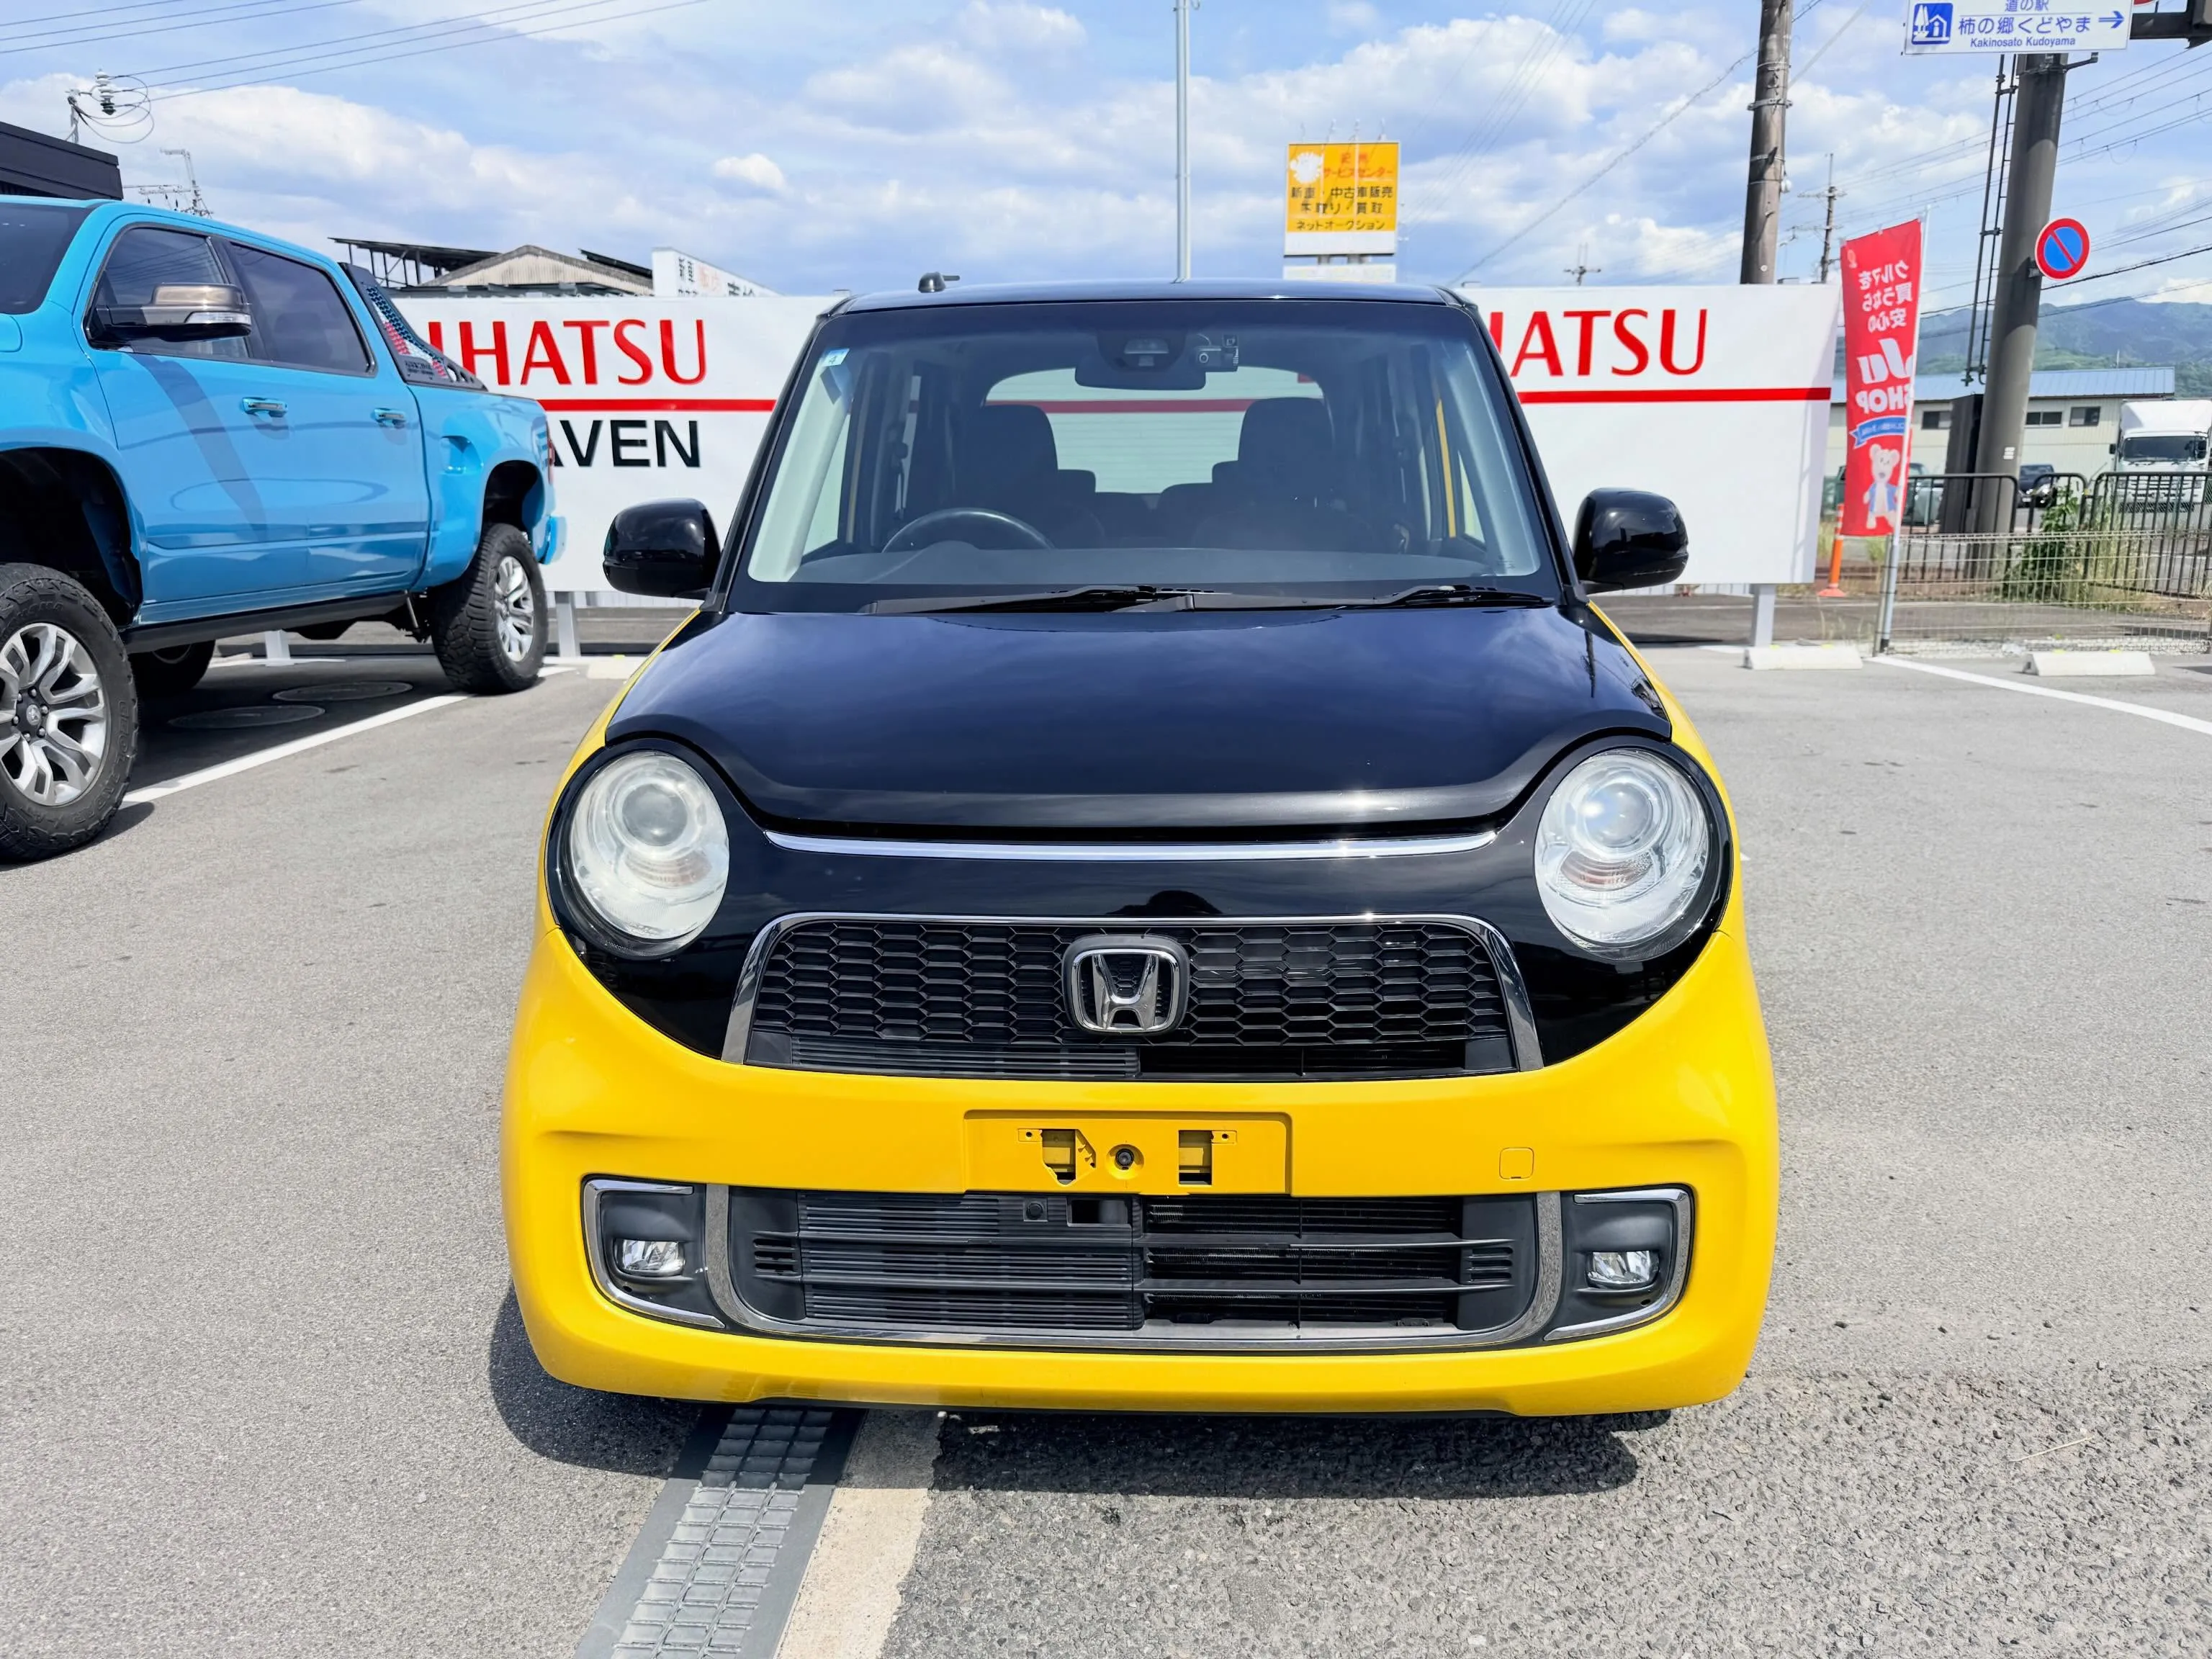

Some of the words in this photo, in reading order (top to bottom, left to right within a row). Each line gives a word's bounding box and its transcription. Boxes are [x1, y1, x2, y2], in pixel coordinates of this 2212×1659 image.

[2005, 0, 2049, 12] 道の駅
[1958, 17, 2090, 35] 柿の郷くどやま
[1970, 37, 2023, 48] Kakinosato
[2026, 37, 2076, 48] Kudoyama
[554, 420, 701, 468] VEN
